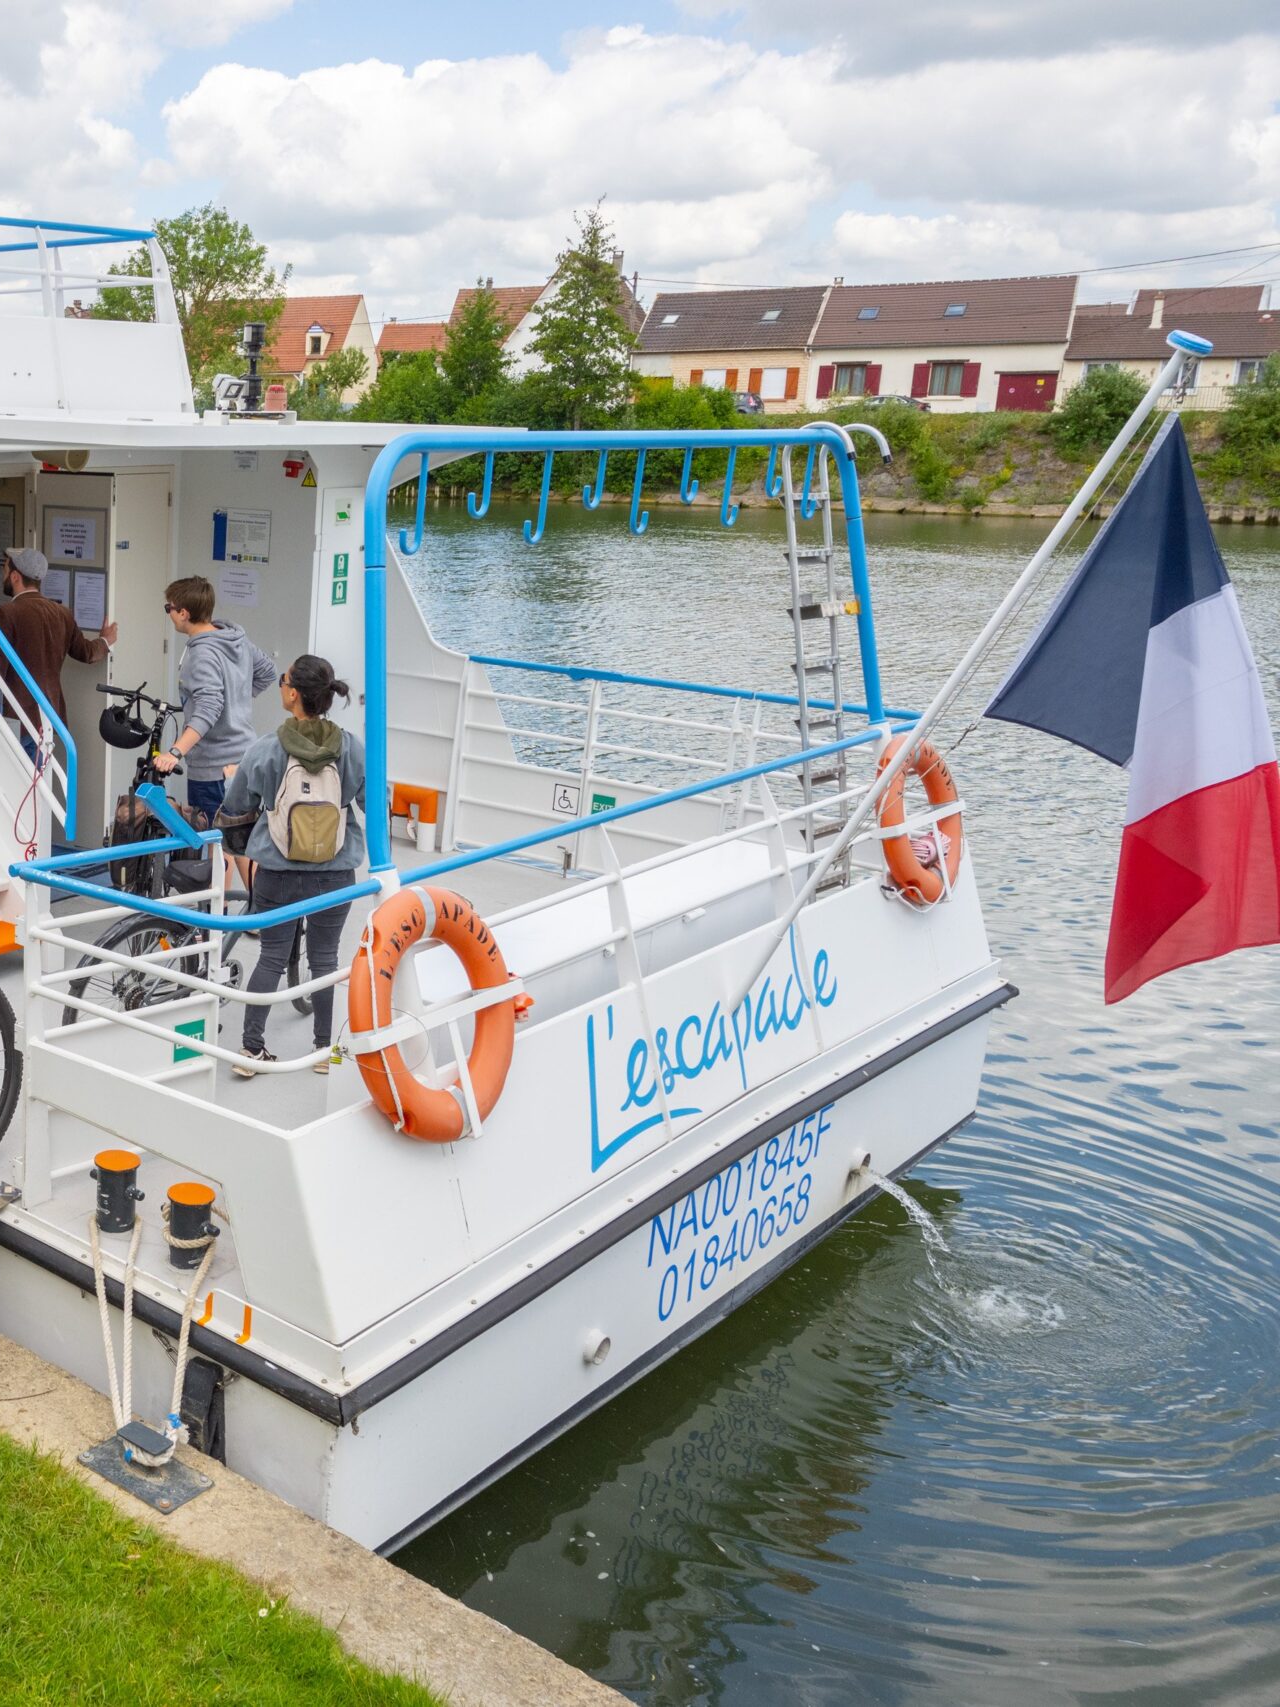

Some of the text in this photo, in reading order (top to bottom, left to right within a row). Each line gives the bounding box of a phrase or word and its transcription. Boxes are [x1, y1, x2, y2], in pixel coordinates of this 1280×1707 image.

[586, 922, 838, 1173] L'escapade
[647, 1102, 836, 1268] NA001845F
[657, 1173, 812, 1322] 01840658
